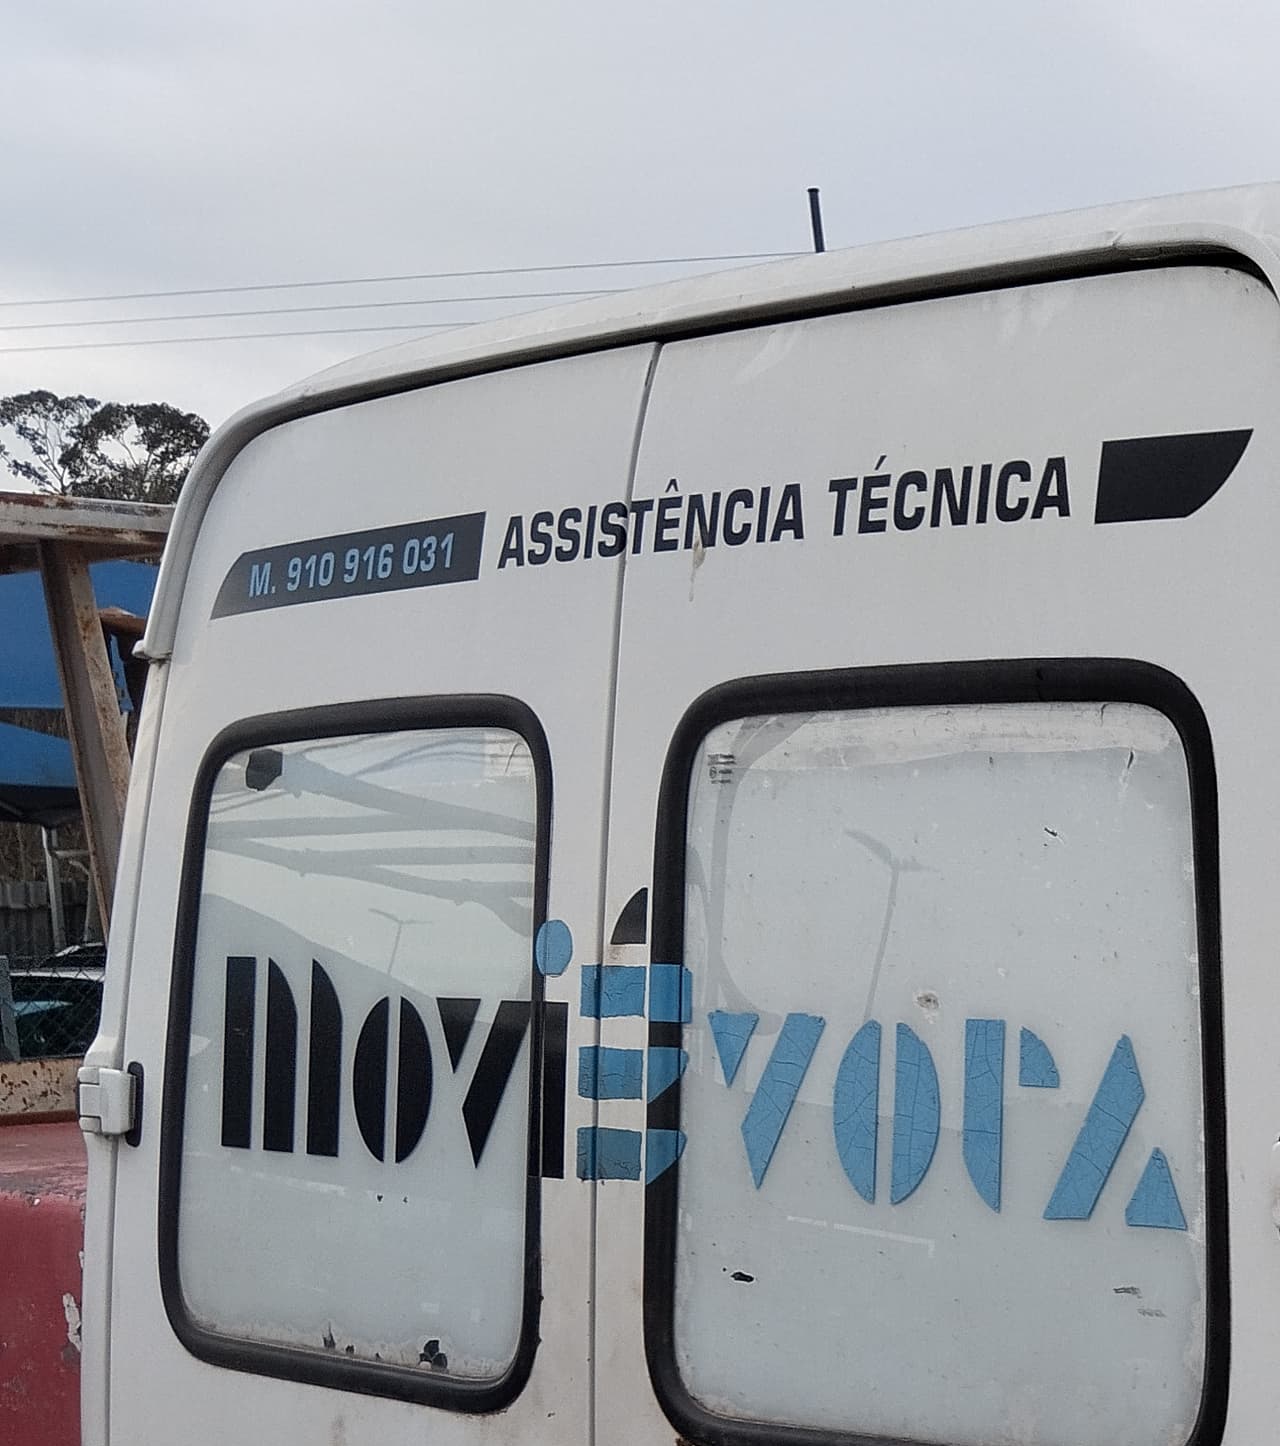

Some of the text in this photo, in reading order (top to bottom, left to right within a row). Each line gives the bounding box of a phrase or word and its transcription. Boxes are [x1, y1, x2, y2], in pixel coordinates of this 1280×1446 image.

[248, 455, 1072, 596] M. 910 916 031 ASSISTÊNCIA TÉCNICA
